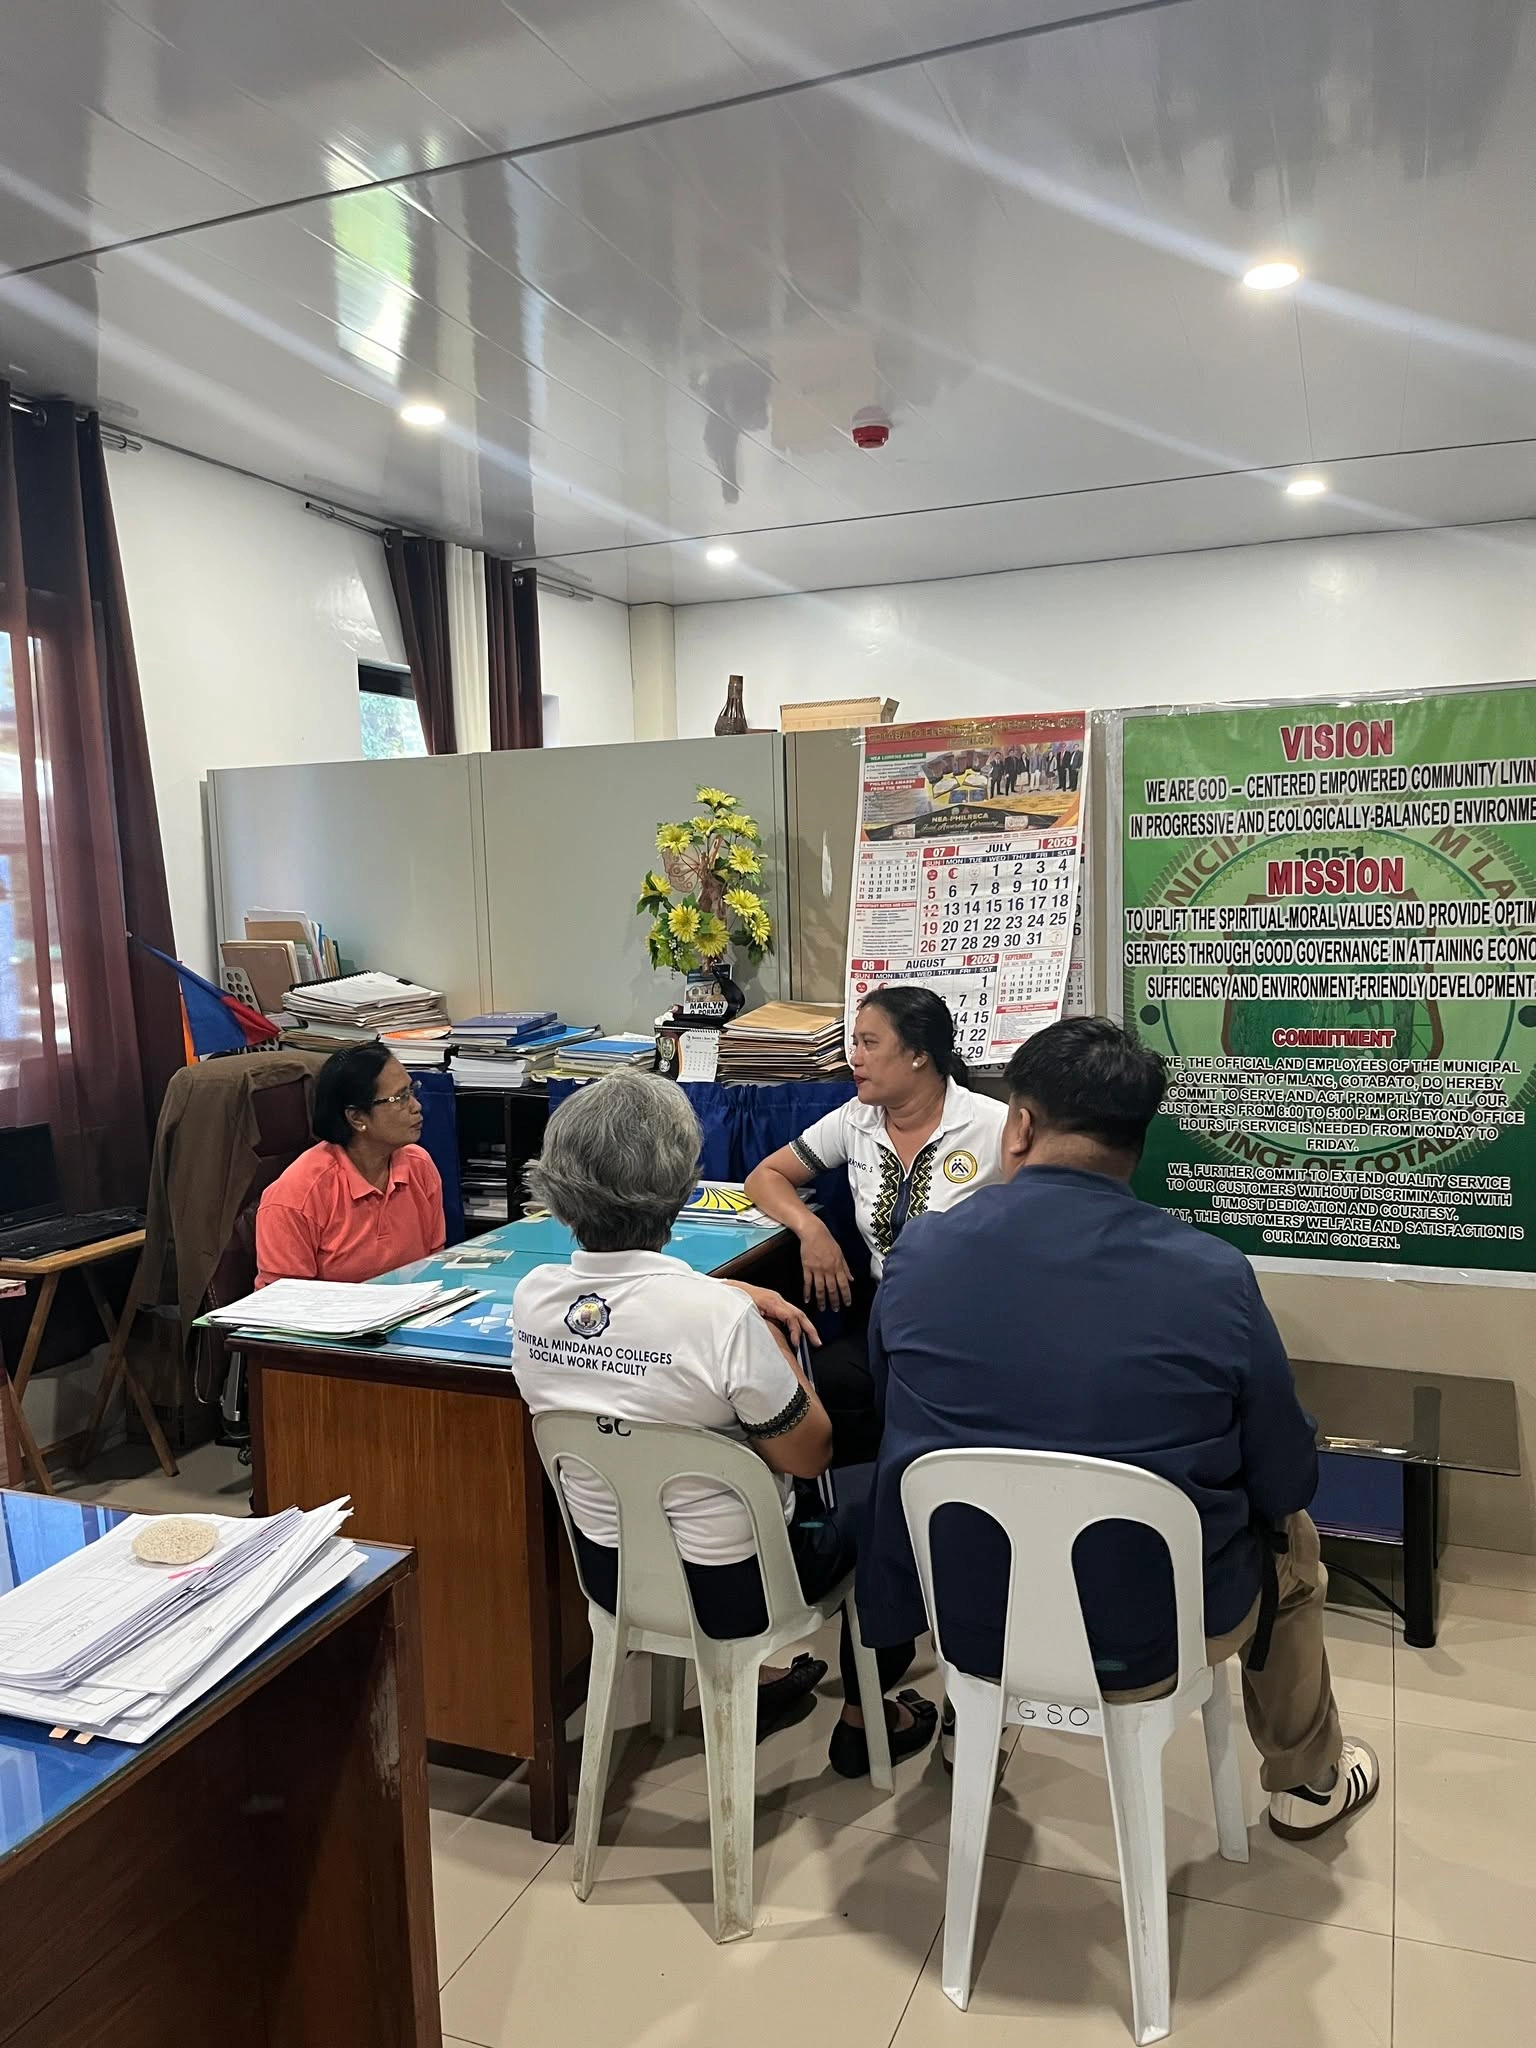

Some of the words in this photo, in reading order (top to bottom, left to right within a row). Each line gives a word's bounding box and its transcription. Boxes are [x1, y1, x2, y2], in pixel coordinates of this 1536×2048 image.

[1280, 720, 1394, 762] VISION
[1146, 780, 1166, 803] WE
[1168, 779, 1195, 801] ARE
[1198, 777, 1227, 801] GOD
[1247, 772, 1316, 798] CENTERED
[1320, 767, 1408, 794] EMPOWERED
[1411, 761, 1497, 790] COMMUNITY
[1130, 815, 1143, 838] IN
[1146, 812, 1234, 837] PROGRESSIVE
[1237, 810, 1265, 834] AND
[1268, 801, 1450, 832] ECOLOGICALLY-BALANCED
[933, 848, 946, 857] 07
[986, 843, 1012, 853] JULY
[1048, 838, 1073, 848] 2026
[1014, 862, 1023, 875] 2
[1036, 860, 1045, 874] 3
[1058, 858, 1067, 871] 4
[1267, 857, 1404, 896] MISSION
[928, 886, 936, 900] 5
[949, 884, 957, 898] 6
[970, 884, 978, 896] 7
[991, 882, 1000, 895] 8
[1012, 880, 1022, 893] 9
[1032, 878, 1048, 892] 10
[1054, 876, 1069, 890] 11
[944, 902, 960, 916] 13
[964, 901, 980, 914] 14
[986, 900, 1002, 912] 15
[1008, 898, 1024, 911] 16
[1030, 896, 1046, 909] 17
[1052, 894, 1068, 907] 18
[1126, 909, 1142, 931] TO
[1146, 908, 1188, 930] UPLIFT
[1191, 908, 1216, 930] THE
[1219, 904, 1336, 930] SPIRITUAL-MORAL
[1339, 903, 1392, 928] VALUES
[1395, 903, 1424, 926] AND
[1429, 901, 1490, 926] PROVIDE
[922, 922, 938, 936] 19
[942, 920, 958, 934] 20
[964, 919, 978, 932] 21
[984, 917, 1000, 930] 22
[1006, 916, 1022, 929] 23
[1027, 914, 1044, 927] 24
[1050, 912, 1066, 926] 25
[920, 940, 936, 953] 26
[940, 938, 957, 952] 27
[961, 936, 978, 950] 28
[982, 934, 1000, 948] 29
[1004, 933, 1020, 947] 30
[1026, 932, 1042, 945] 31
[1126, 942, 1186, 965] SERVICES
[1189, 942, 1250, 964] THROUGH
[1254, 941, 1292, 964] GOOD
[1296, 939, 1389, 964] GOVERNANCE
[1392, 939, 1405, 963] IN
[1409, 938, 1483, 962] ATTAINING
[862, 960, 875, 970] 08
[906, 958, 946, 970] AUGUST
[971, 955, 996, 965] 2026
[1147, 976, 1228, 999] SUFFICIENCY
[1231, 975, 1258, 998] AND
[1262, 975, 1427, 999] ENVIRONMENT-FRIENDLY
[690, 1001, 724, 1010] MARLYN
[1273, 1029, 1395, 1047] COMMITMENT
[1188, 1057, 1212, 1068] THE
[1215, 1057, 1272, 1069] OFFICIAL
[1275, 1058, 1303, 1070] AND
[1306, 1059, 1387, 1071] EMPLOYEES
[1390, 1060, 1409, 1072] OF
[1412, 1061, 1440, 1072] THE
[1443, 1061, 1521, 1073] MUNICIPAL
[1176, 1072, 1264, 1085] GOVERNMENT
[1266, 1074, 1285, 1085] OF
[1287, 1074, 1337, 1089] MLANG,
[1341, 1075, 1419, 1090] COTABATO,
[1422, 1077, 1442, 1088] DO
[1446, 1077, 1504, 1090] HEREBY
[1168, 1087, 1218, 1099] COMMIT
[1221, 1088, 1238, 1100] TO
[1240, 1089, 1285, 1101] SERVE
[1287, 1090, 1314, 1102] AND
[1317, 1091, 1344, 1103] ACT
[1346, 1092, 1420, 1104] PROMPTLY
[1423, 1094, 1442, 1105] TO
[1446, 1094, 1473, 1106] ALL
[1476, 1095, 1508, 1107] OUR
[1158, 1103, 1236, 1115] CUSTOMERS
[1238, 1105, 1275, 1117] FROM
[1277, 1106, 1303, 1117] 8:00
[1306, 1107, 1325, 1118] TO
[1327, 1108, 1353, 1119] 5:00
[1357, 1108, 1384, 1120] P.M.
[1387, 1109, 1411, 1121] OR
[1412, 1110, 1469, 1123] BEYOND
[1472, 1111, 1525, 1124] OFFICE
[1180, 1118, 1224, 1130] HOURS
[1227, 1120, 1238, 1131] IF
[1241, 1120, 1296, 1133] SERVICE
[1299, 1122, 1312, 1133] IS
[1315, 1123, 1368, 1135] NEEDED
[1372, 1125, 1410, 1136] FROM
[1414, 1126, 1475, 1139] MONDAY
[1477, 1128, 1498, 1140] TO
[1307, 1139, 1359, 1151] FRIDAY.
[1168, 1163, 1193, 1178] WE,
[1195, 1165, 1253, 1179] FURTHER
[1256, 1168, 1307, 1180] COMMIT
[1310, 1170, 1328, 1181] TO
[1331, 1171, 1384, 1184] EXTEND
[1387, 1173, 1446, 1187] QUALITY
[1448, 1176, 1510, 1190] SERVICE
[1166, 1178, 1185, 1190] TO
[1187, 1180, 1215, 1192] OUR
[1217, 1182, 1295, 1195] CUSTOMERS
[1298, 1185, 1359, 1199] WITHOUT
[1361, 1187, 1473, 1205] DISCRIMINATION
[1475, 1193, 1512, 1206] WITH
[1212, 1196, 1266, 1209] UTMOST
[1267, 1199, 1346, 1214] DEDICATION
[1349, 1203, 1378, 1215] AND
[1380, 1204, 1460, 1220] COURTESY.
[1194, 1210, 1220, 1223] THE
[1306, 1215, 1371, 1231] WELFARE
[1373, 1220, 1404, 1233] AND
[1405, 1222, 1506, 1239] SATISFACTION
[1509, 1226, 1524, 1239] IS
[1263, 1230, 1293, 1243] OUR
[1294, 1232, 1328, 1245] MAIN
[1330, 1233, 1400, 1249] CONCERN.
[517, 1329, 549, 1349] CENTRAL
[551, 1339, 613, 1358] MINDANAO
[615, 1348, 673, 1365] COLLEGES
[529, 1350, 565, 1365] SOCIAL
[567, 1356, 599, 1370] WORK
[601, 1361, 647, 1376] FACULTY
